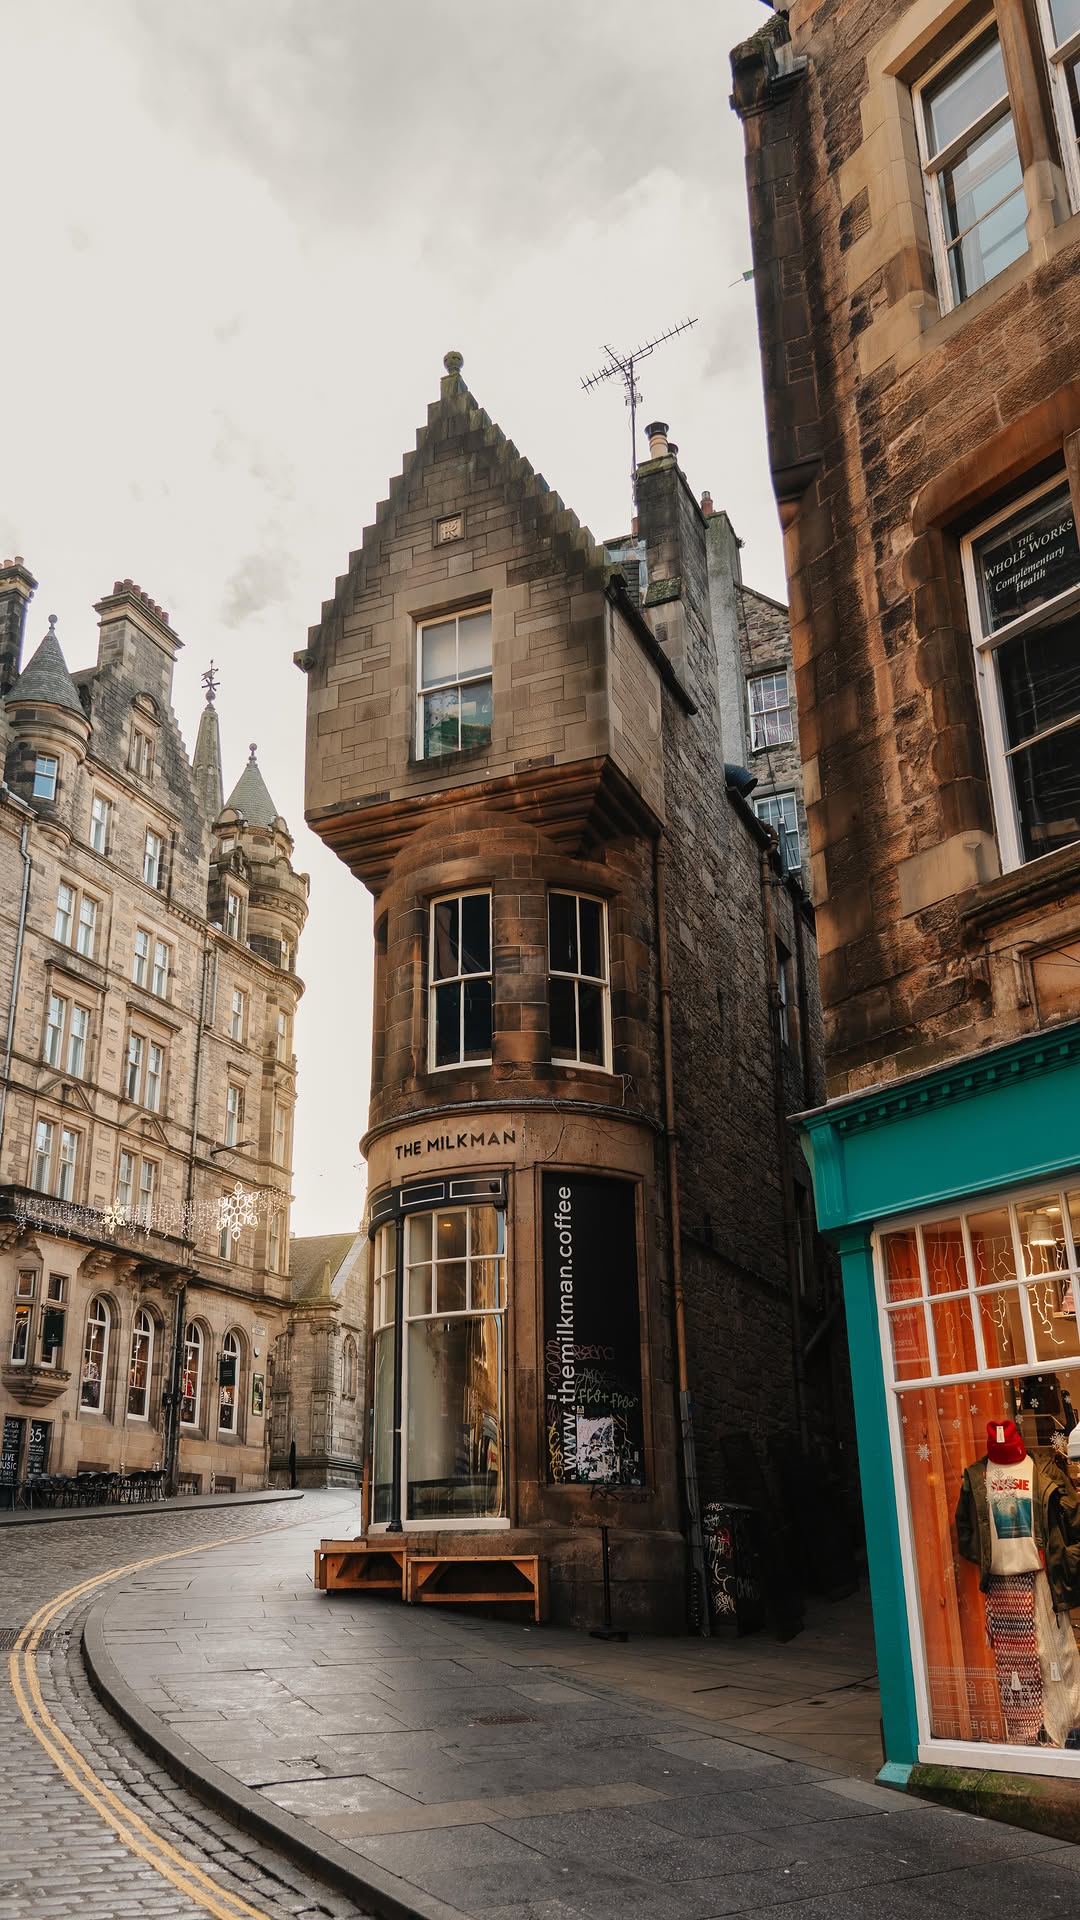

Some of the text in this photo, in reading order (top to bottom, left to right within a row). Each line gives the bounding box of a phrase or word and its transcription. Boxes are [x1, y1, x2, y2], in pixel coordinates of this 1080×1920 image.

[984, 519, 1073, 581] WHOLE WORKS
[1017, 532, 1035, 548] THE
[995, 546, 1065, 592] Complementary
[1016, 568, 1046, 593] Health
[395, 1130, 516, 1159] THE MILKMAN
[554, 1186, 577, 1471] www.themilkman.coffee
[1, 1453, 15, 1462] LIVE
